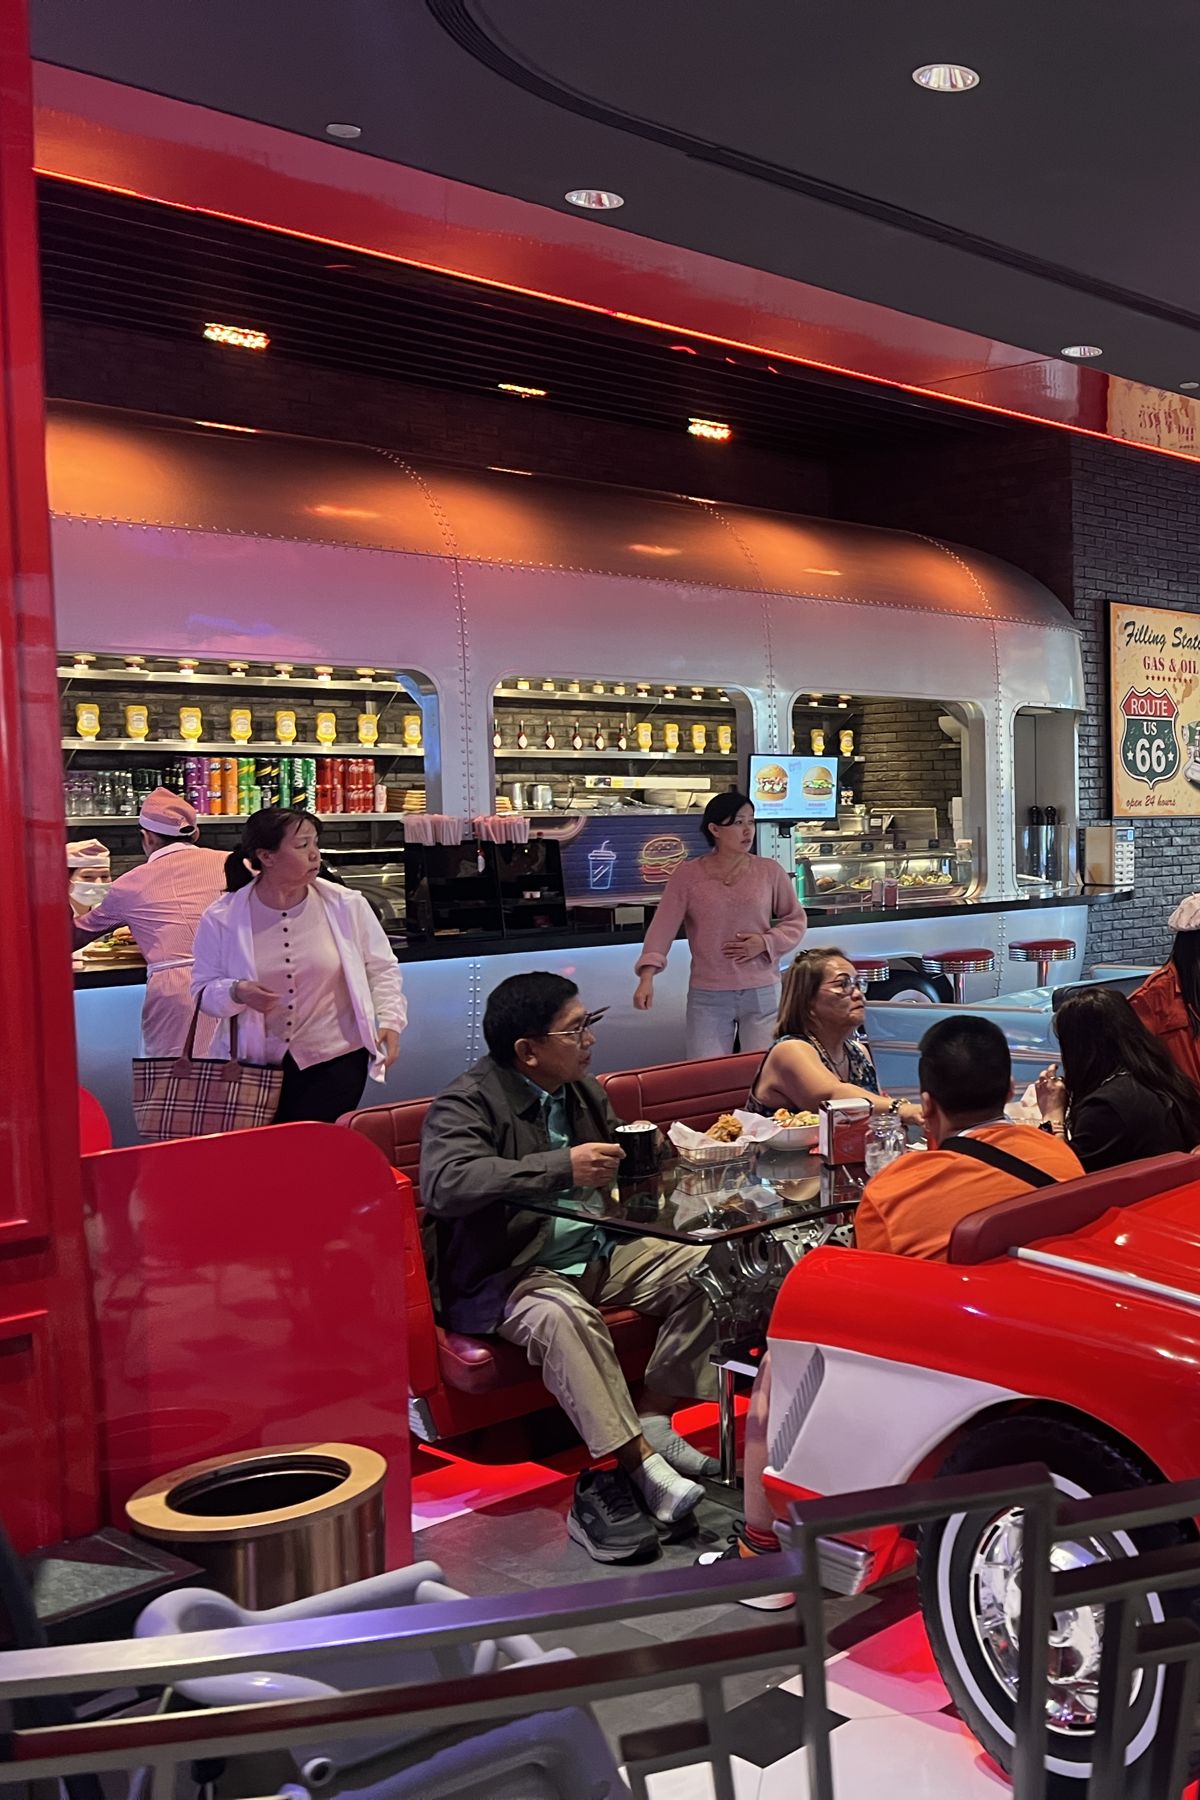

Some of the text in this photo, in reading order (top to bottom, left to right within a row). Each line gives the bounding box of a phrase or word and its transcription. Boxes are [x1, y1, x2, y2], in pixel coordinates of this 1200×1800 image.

[1124, 620, 1167, 653] Filling
[1142, 655, 1199, 675] GAS & OIL
[1130, 698, 1168, 716] ROUTE
[1142, 721, 1158, 735] US
[1135, 738, 1166, 773] 66
[1126, 795, 1176, 810] open 24 hours
